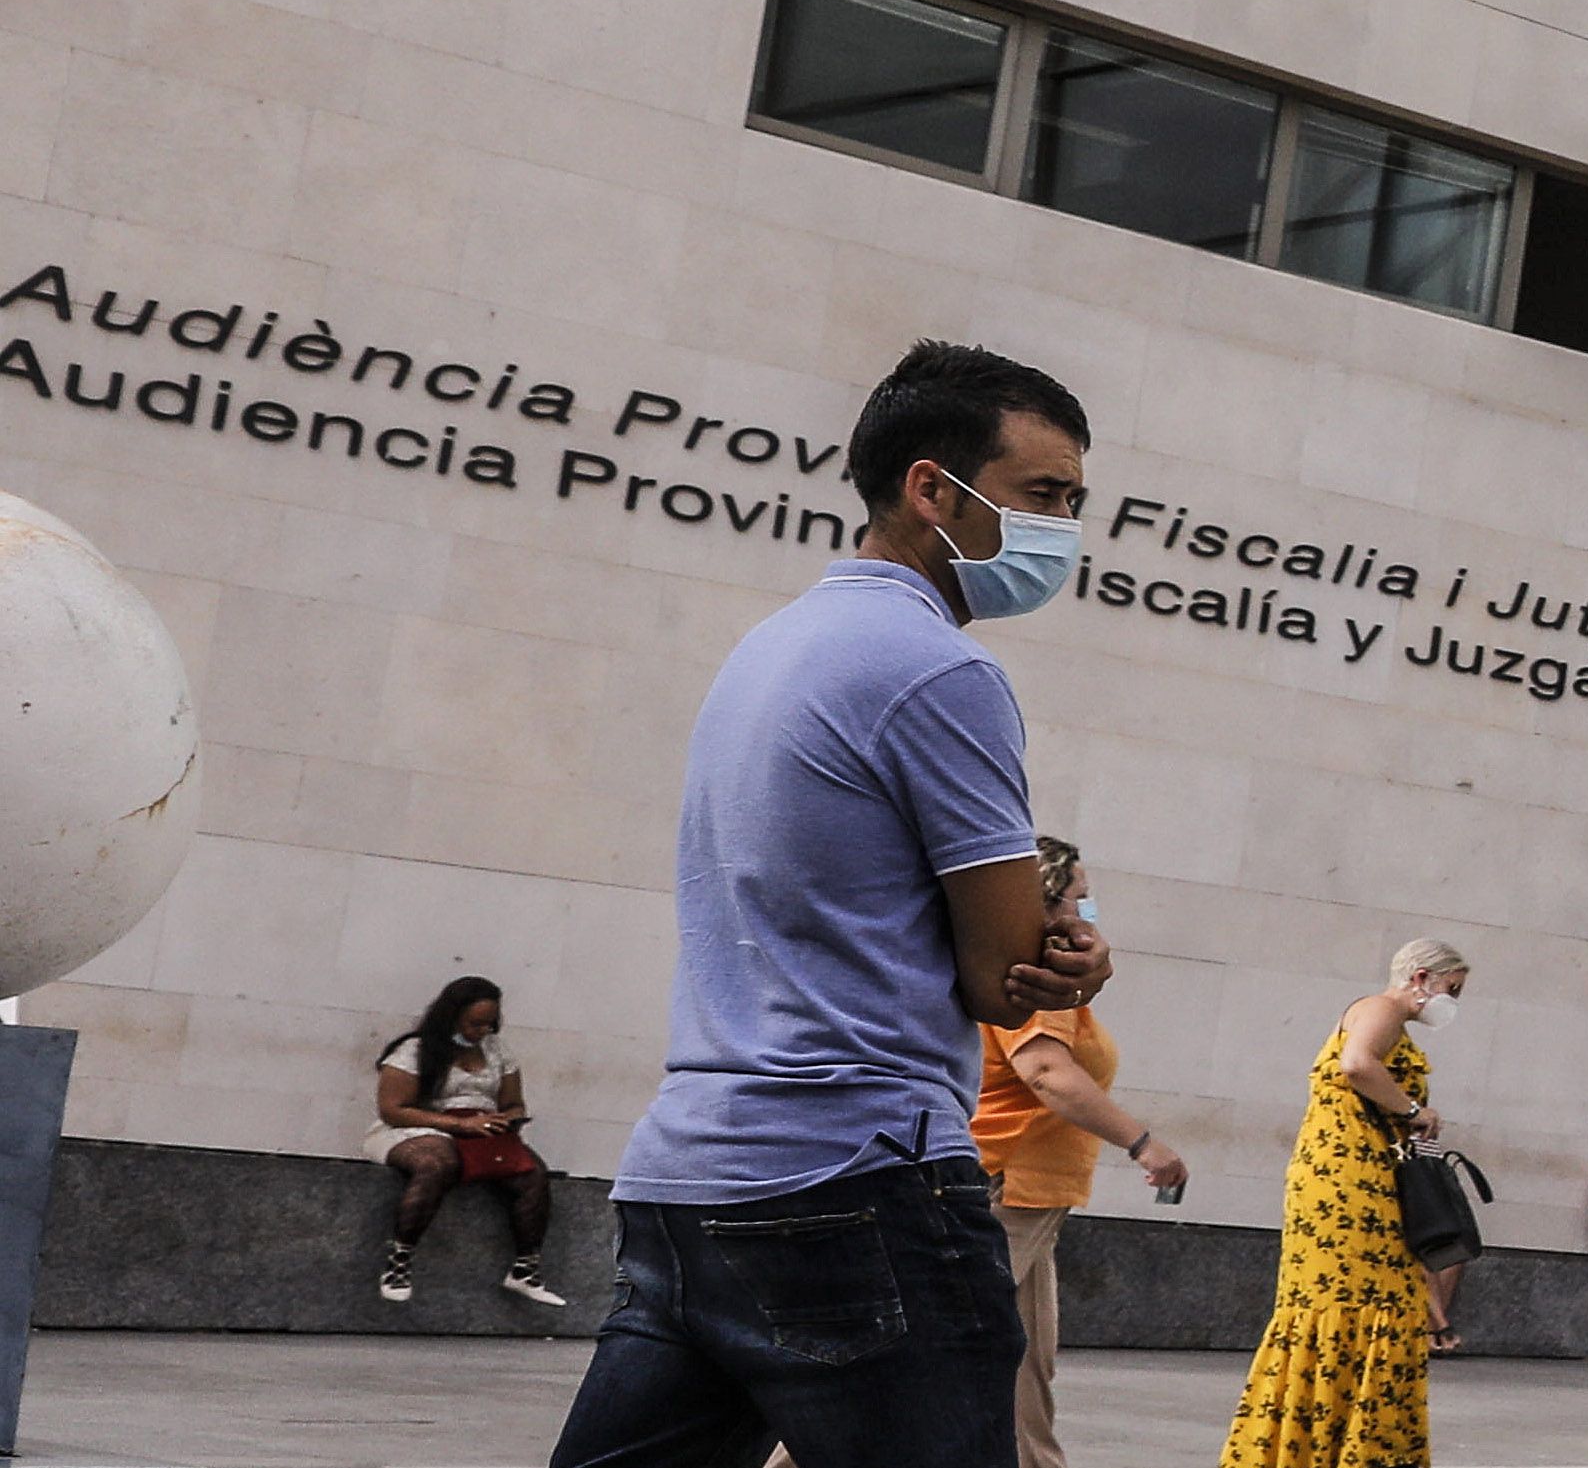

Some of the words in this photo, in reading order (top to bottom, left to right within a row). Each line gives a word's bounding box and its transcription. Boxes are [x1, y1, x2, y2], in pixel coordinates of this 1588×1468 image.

[0, 265, 576, 425] Audiència
[1108, 495, 1417, 599] Fiscalia
[1445, 568, 1468, 609] i
[0, 337, 518, 489] Audiencia
[557, 449, 874, 552] Provin
[1075, 554, 1318, 644] iscalía
[1343, 618, 1384, 664] y
